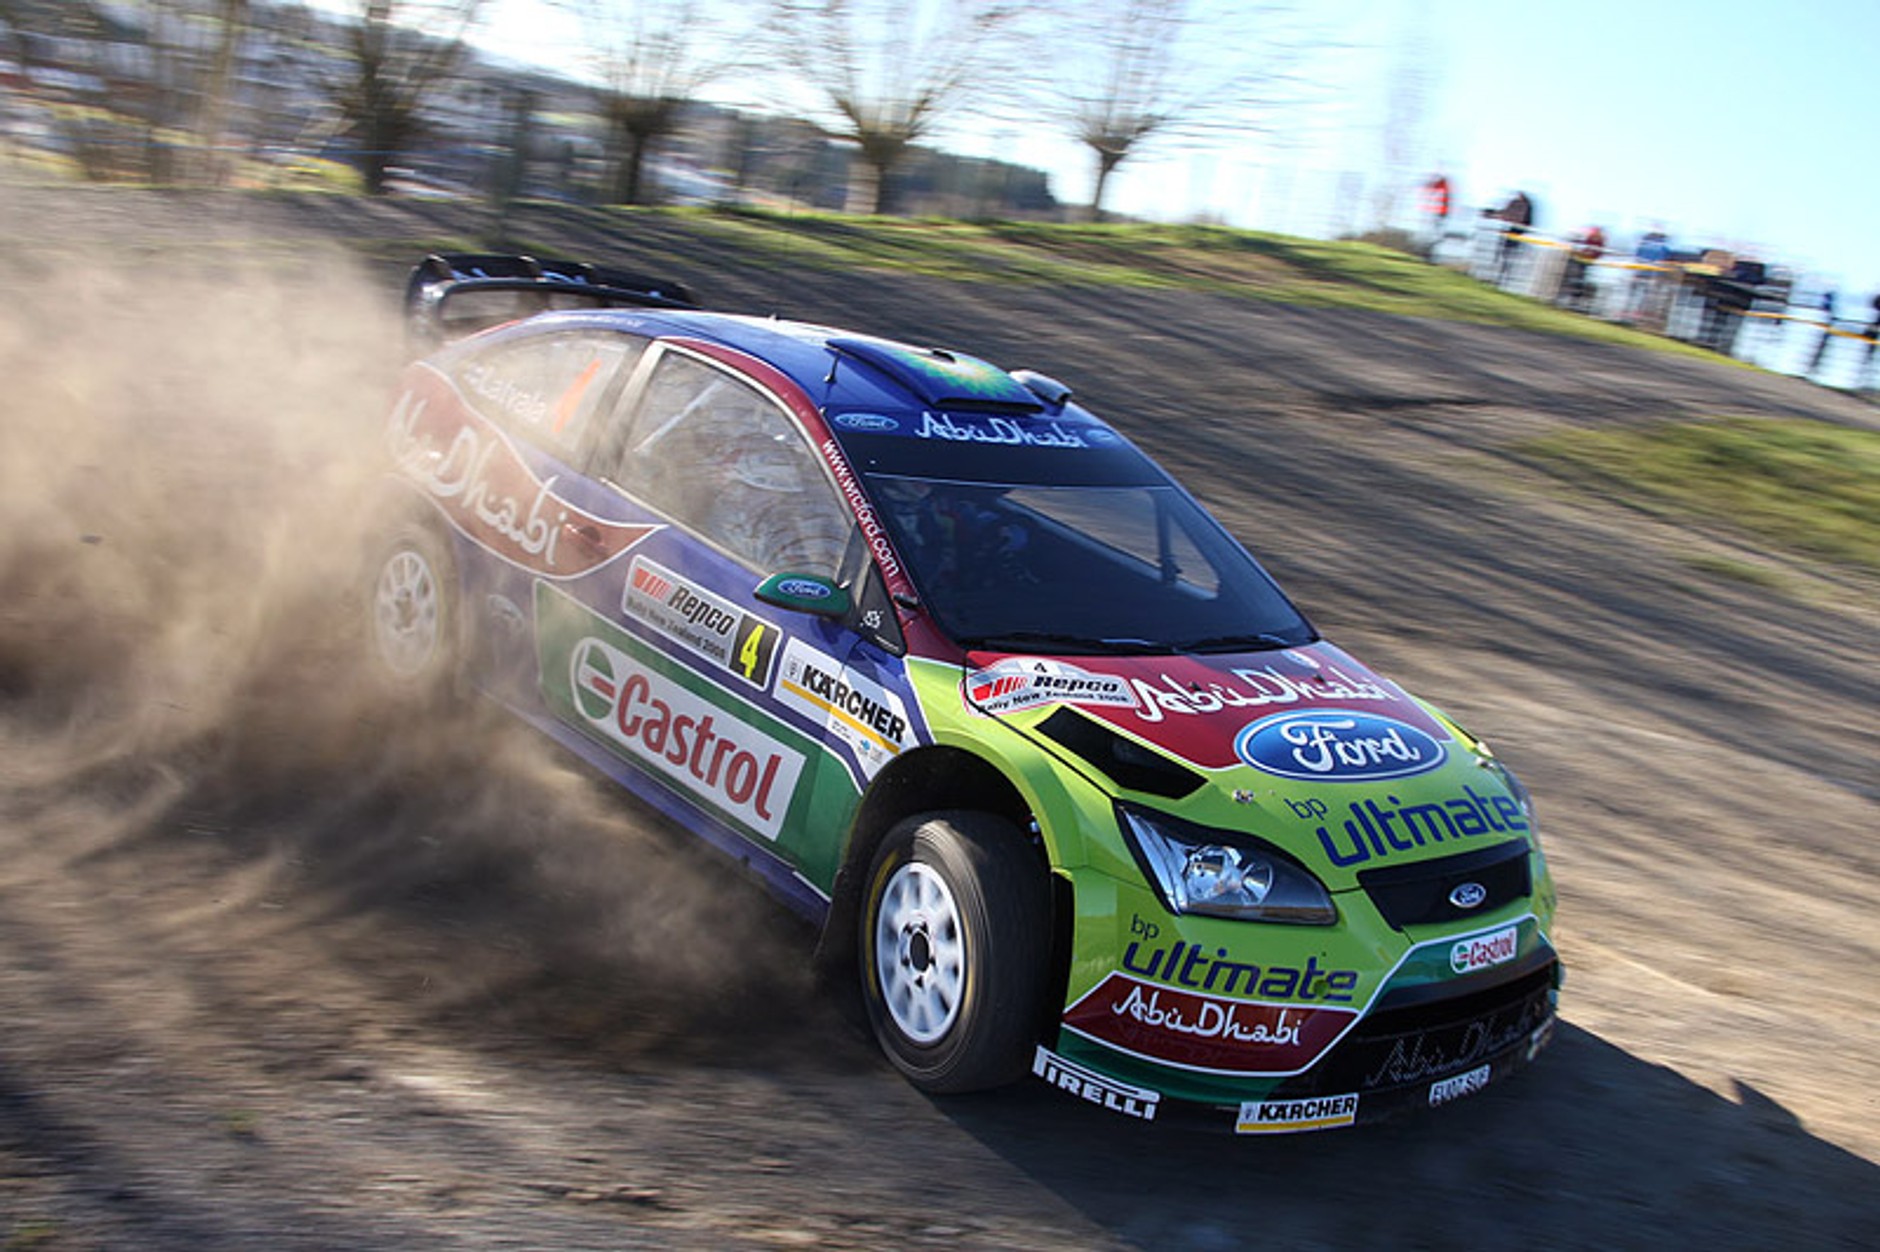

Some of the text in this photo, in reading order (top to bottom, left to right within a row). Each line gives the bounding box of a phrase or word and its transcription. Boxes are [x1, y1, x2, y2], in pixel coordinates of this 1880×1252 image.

[668, 585, 735, 636] Repco
[740, 624, 765, 678] 4
[801, 665, 906, 743] KÄRCHER
[1033, 676, 1119, 692] Repco
[617, 674, 782, 821] Castrol
[1281, 720, 1421, 772] Ford
[1283, 797, 1328, 820] bp
[1315, 784, 1528, 868] ultimate
[1130, 914, 1160, 941] bp
[1122, 941, 1357, 1001] ultimate
[1032, 1045, 1161, 1122] PIRELLI
